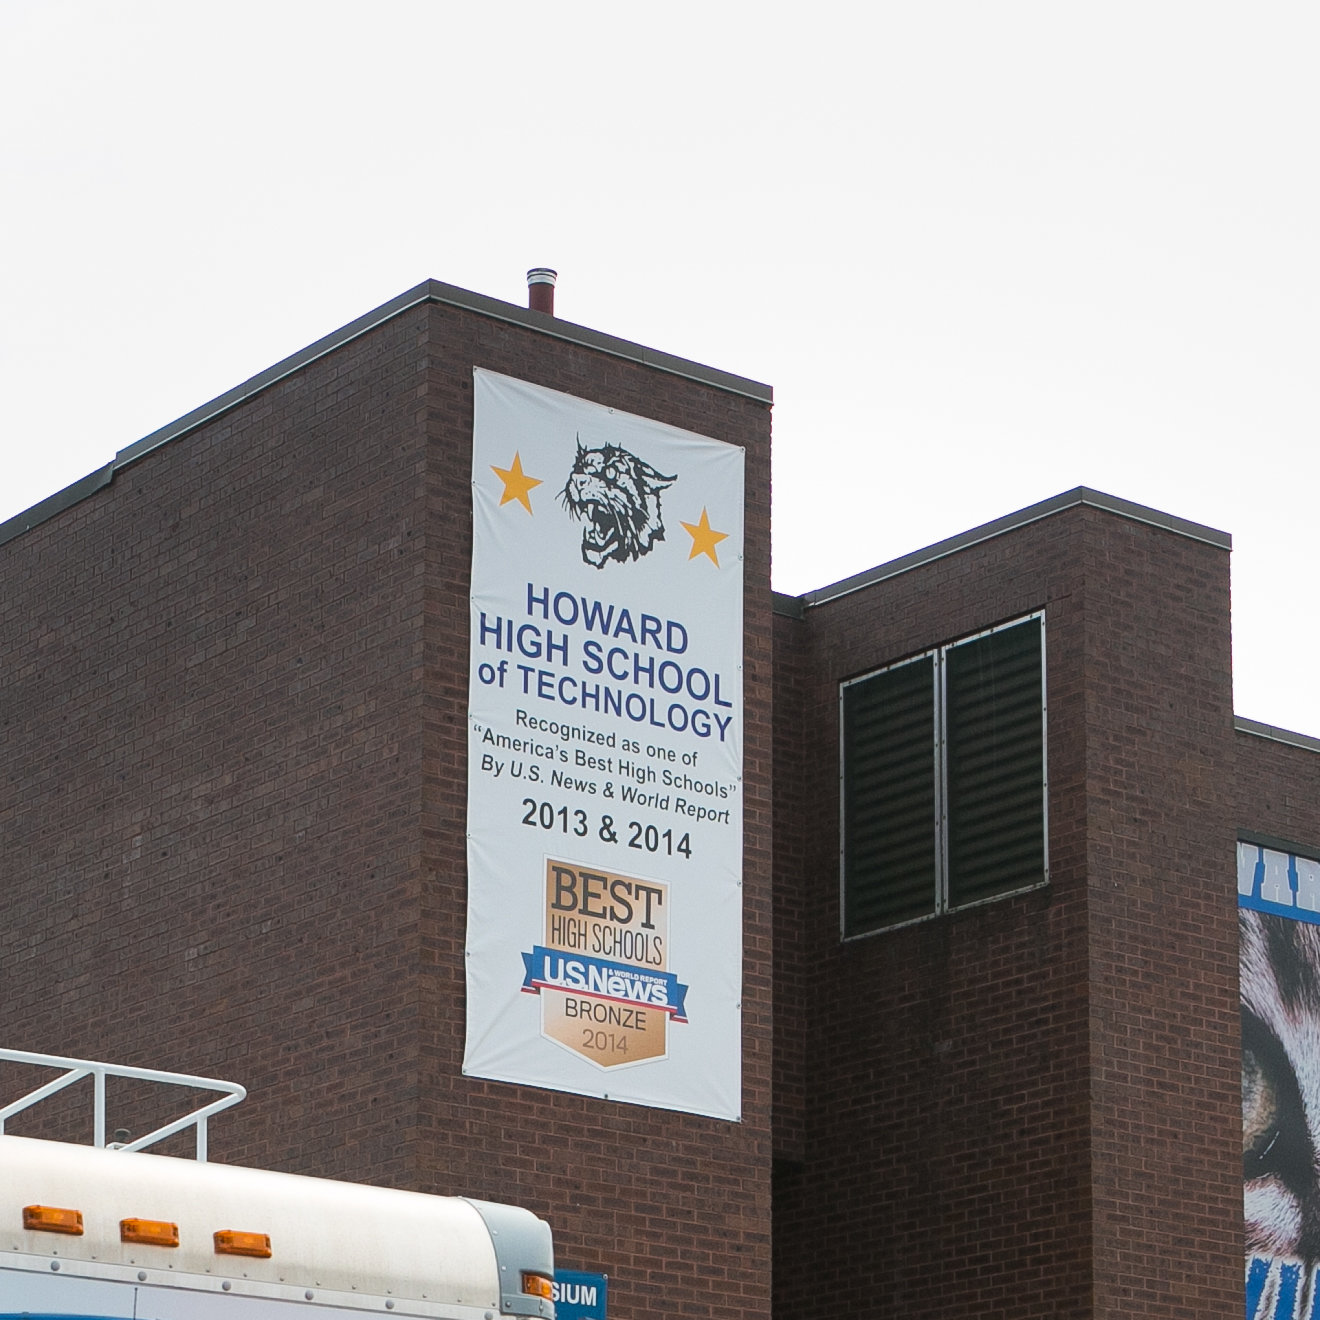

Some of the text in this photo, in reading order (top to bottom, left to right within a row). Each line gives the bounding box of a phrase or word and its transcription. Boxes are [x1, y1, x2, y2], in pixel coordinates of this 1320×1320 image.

[527, 582, 689, 655] HOWARD
[479, 611, 733, 709] HIGH SCHOOL
[478, 660, 733, 743] of TECHNOLOGY
[515, 709, 698, 768] Recognized as one of
[574, 749, 614, 774] Best
[618, 760, 657, 785] High
[481, 754, 731, 825] By U.S. News & World Report
[522, 798, 693, 860] 2013 & 2014
[550, 865, 664, 931] BEST
[550, 913, 664, 966] HIGH SCHOOLS
[614, 970, 640, 981] WORLD
[639, 974, 668, 986] REPORT
[565, 997, 647, 1031] BRONZE
[582, 1028, 629, 1055] 2014
